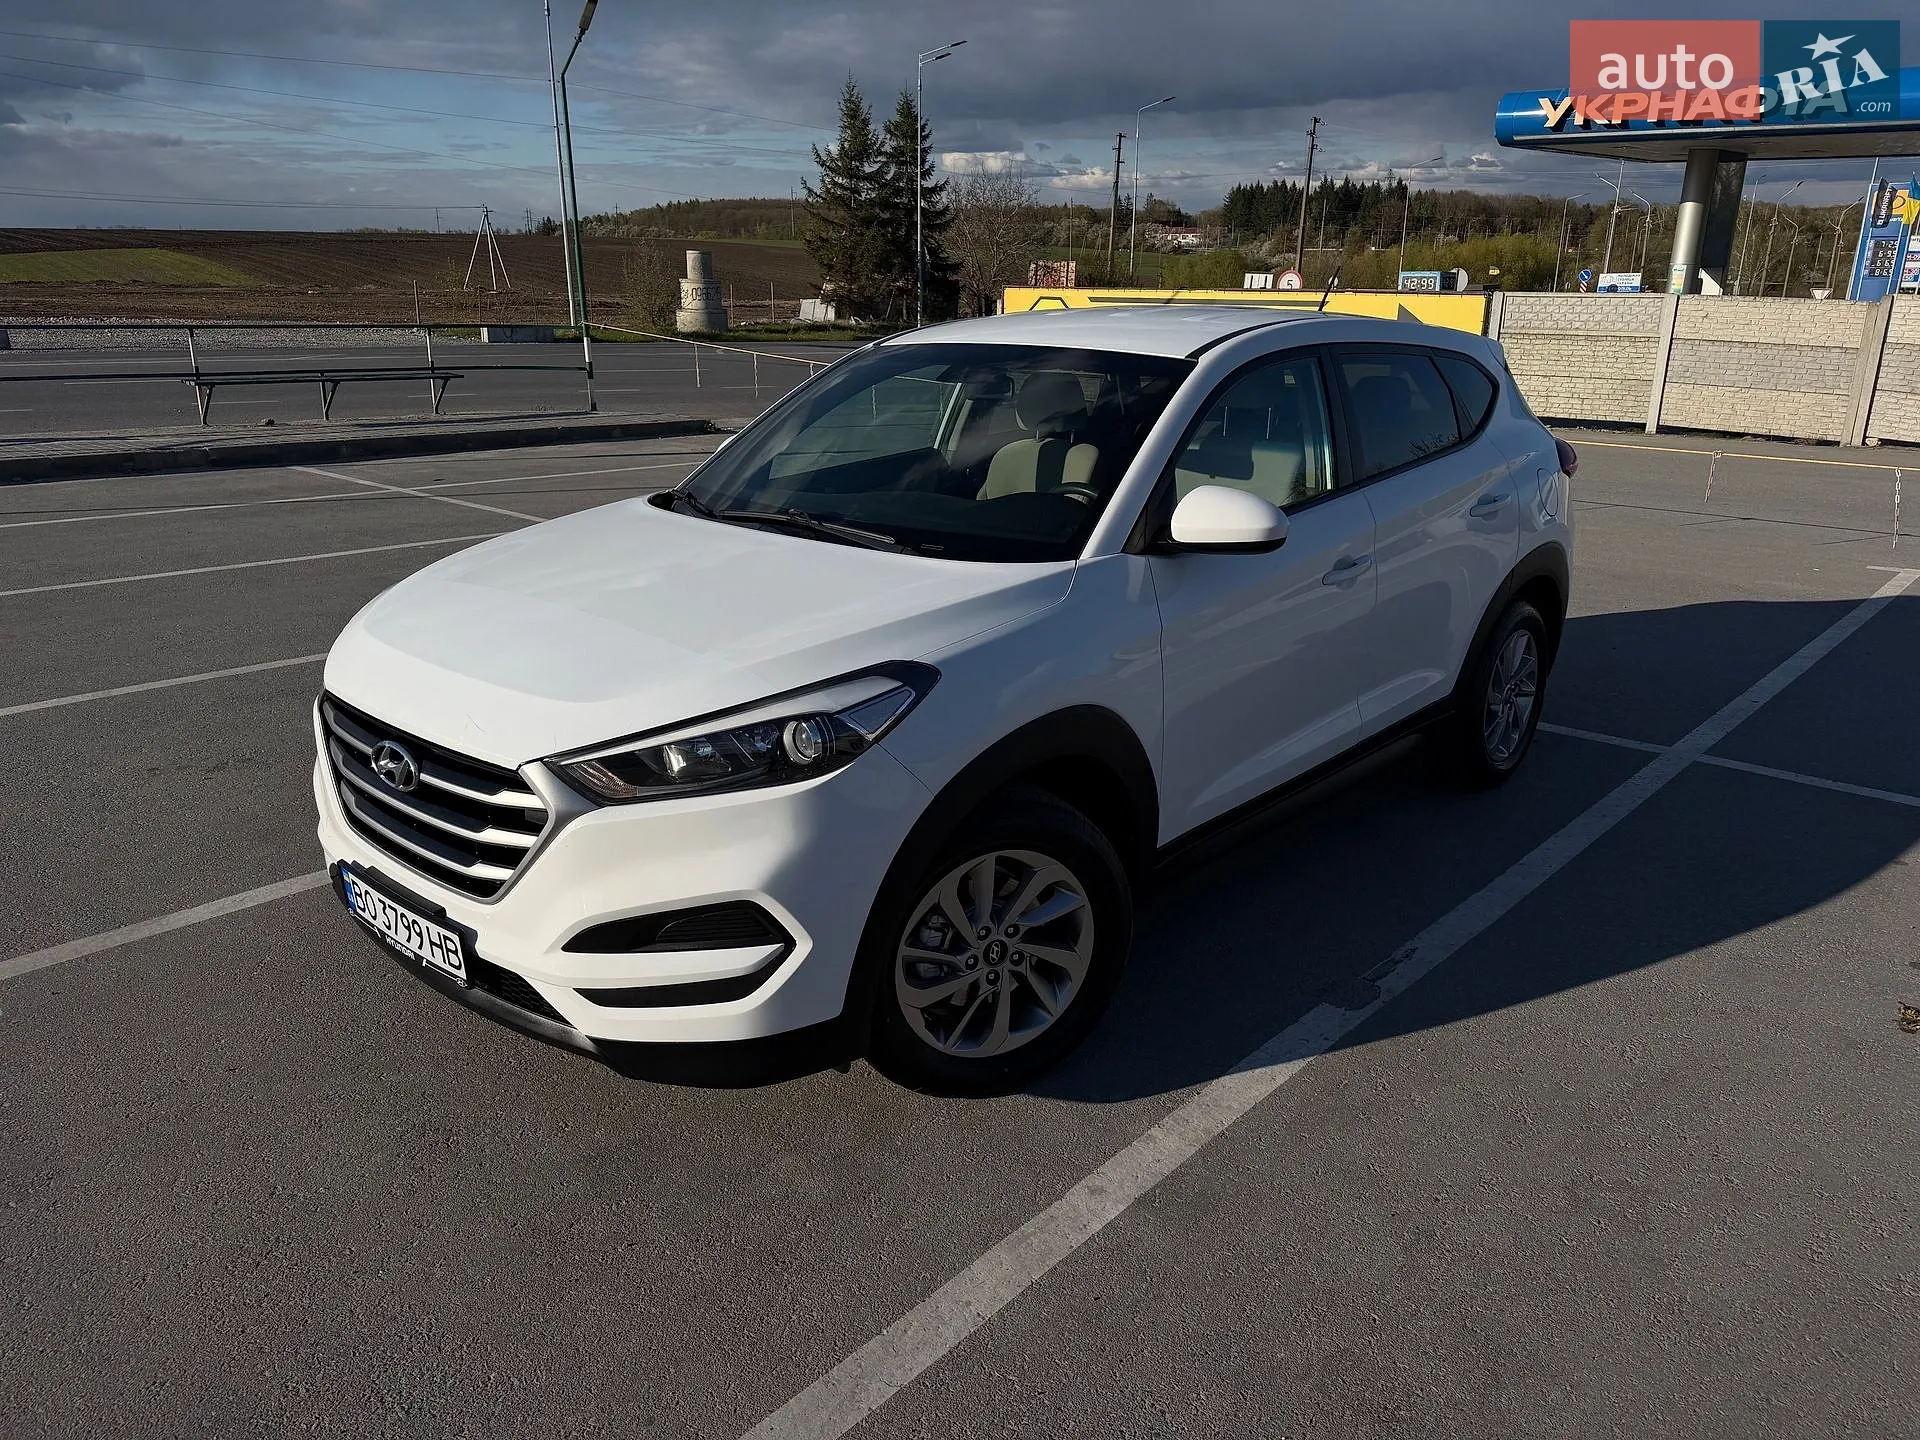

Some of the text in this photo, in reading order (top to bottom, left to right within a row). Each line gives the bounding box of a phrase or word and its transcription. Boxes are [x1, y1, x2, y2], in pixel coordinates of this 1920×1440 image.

[351, 879, 462, 970] BO 3799 HB
[385, 936, 416, 960] HYUNDAI
